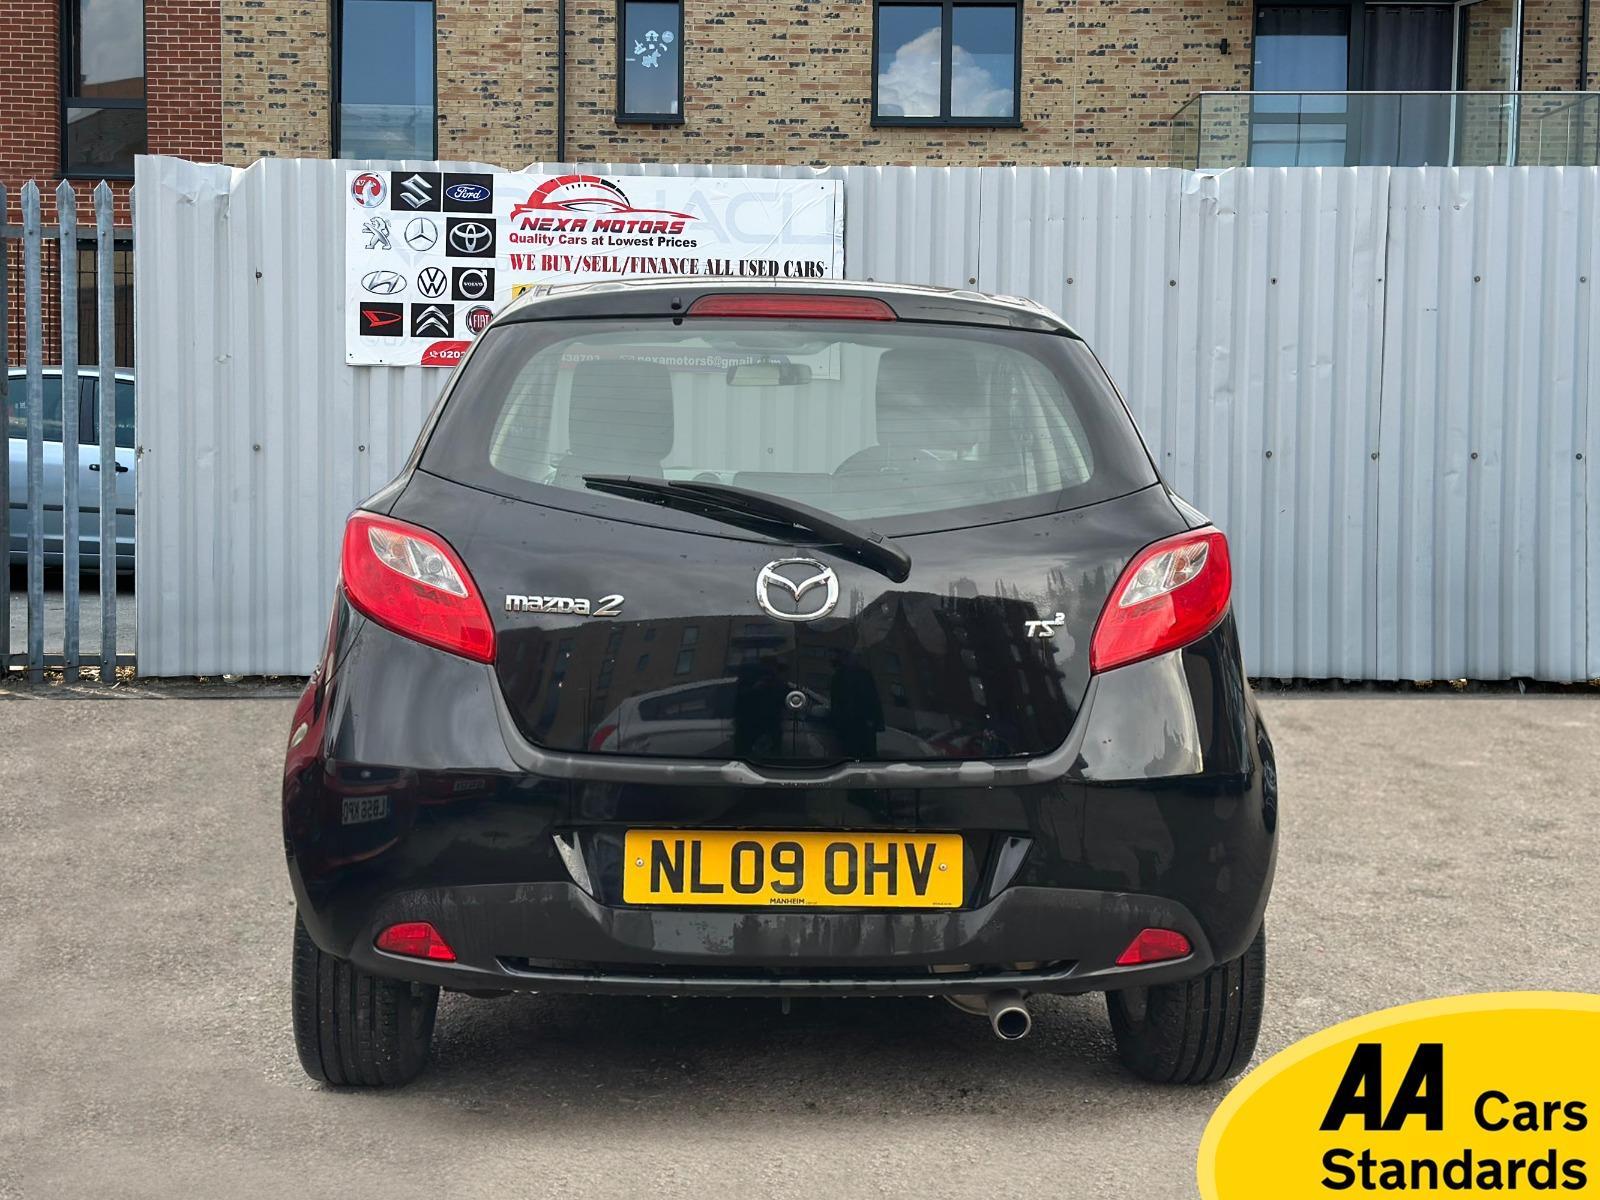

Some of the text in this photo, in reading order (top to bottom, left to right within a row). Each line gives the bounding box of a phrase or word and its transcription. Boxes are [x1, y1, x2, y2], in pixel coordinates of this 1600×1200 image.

[454, 186, 482, 199] Ford
[520, 217, 686, 235] NEXA MOTORS
[509, 232, 697, 248] Quality Cars at Lowest Prices
[510, 253, 536, 271] WE
[704, 258, 734, 276] ALL
[739, 259, 780, 277] USED
[473, 314, 490, 328] FIAT
[650, 840, 936, 896] NL09 OHV
